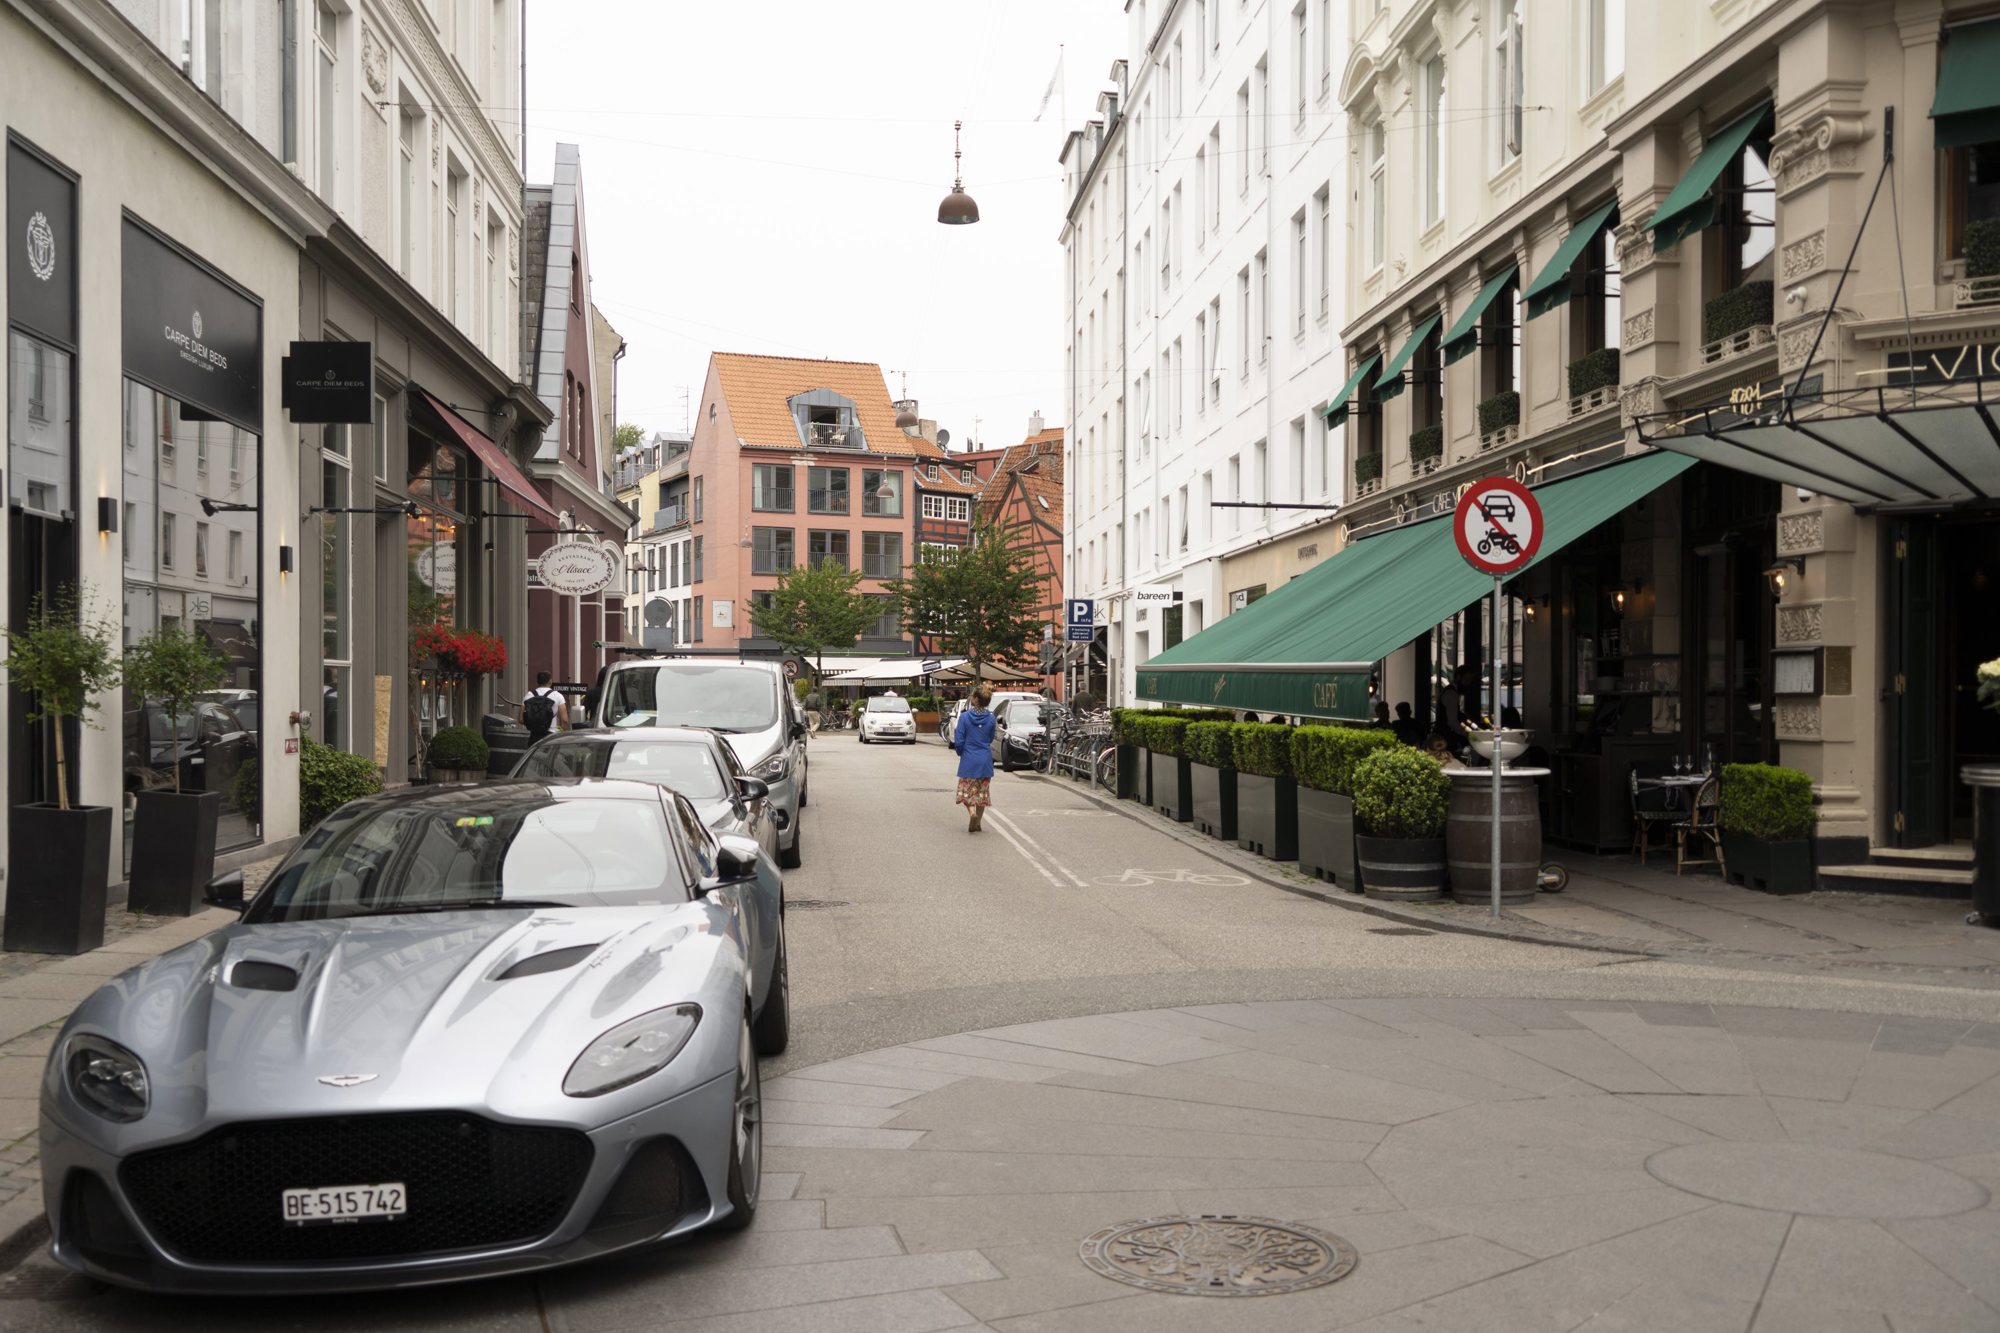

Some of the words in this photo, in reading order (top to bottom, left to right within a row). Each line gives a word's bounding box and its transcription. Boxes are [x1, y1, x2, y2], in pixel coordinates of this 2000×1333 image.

[165, 326, 190, 350] CARPE
[191, 340, 208, 359] DIEM
[209, 349, 227, 369] BEDS
[1137, 592, 1170, 600] bareen
[1074, 602, 1088, 622] P
[570, 685, 588, 693] VINTAGE
[1314, 675, 1338, 708] CAFÉ
